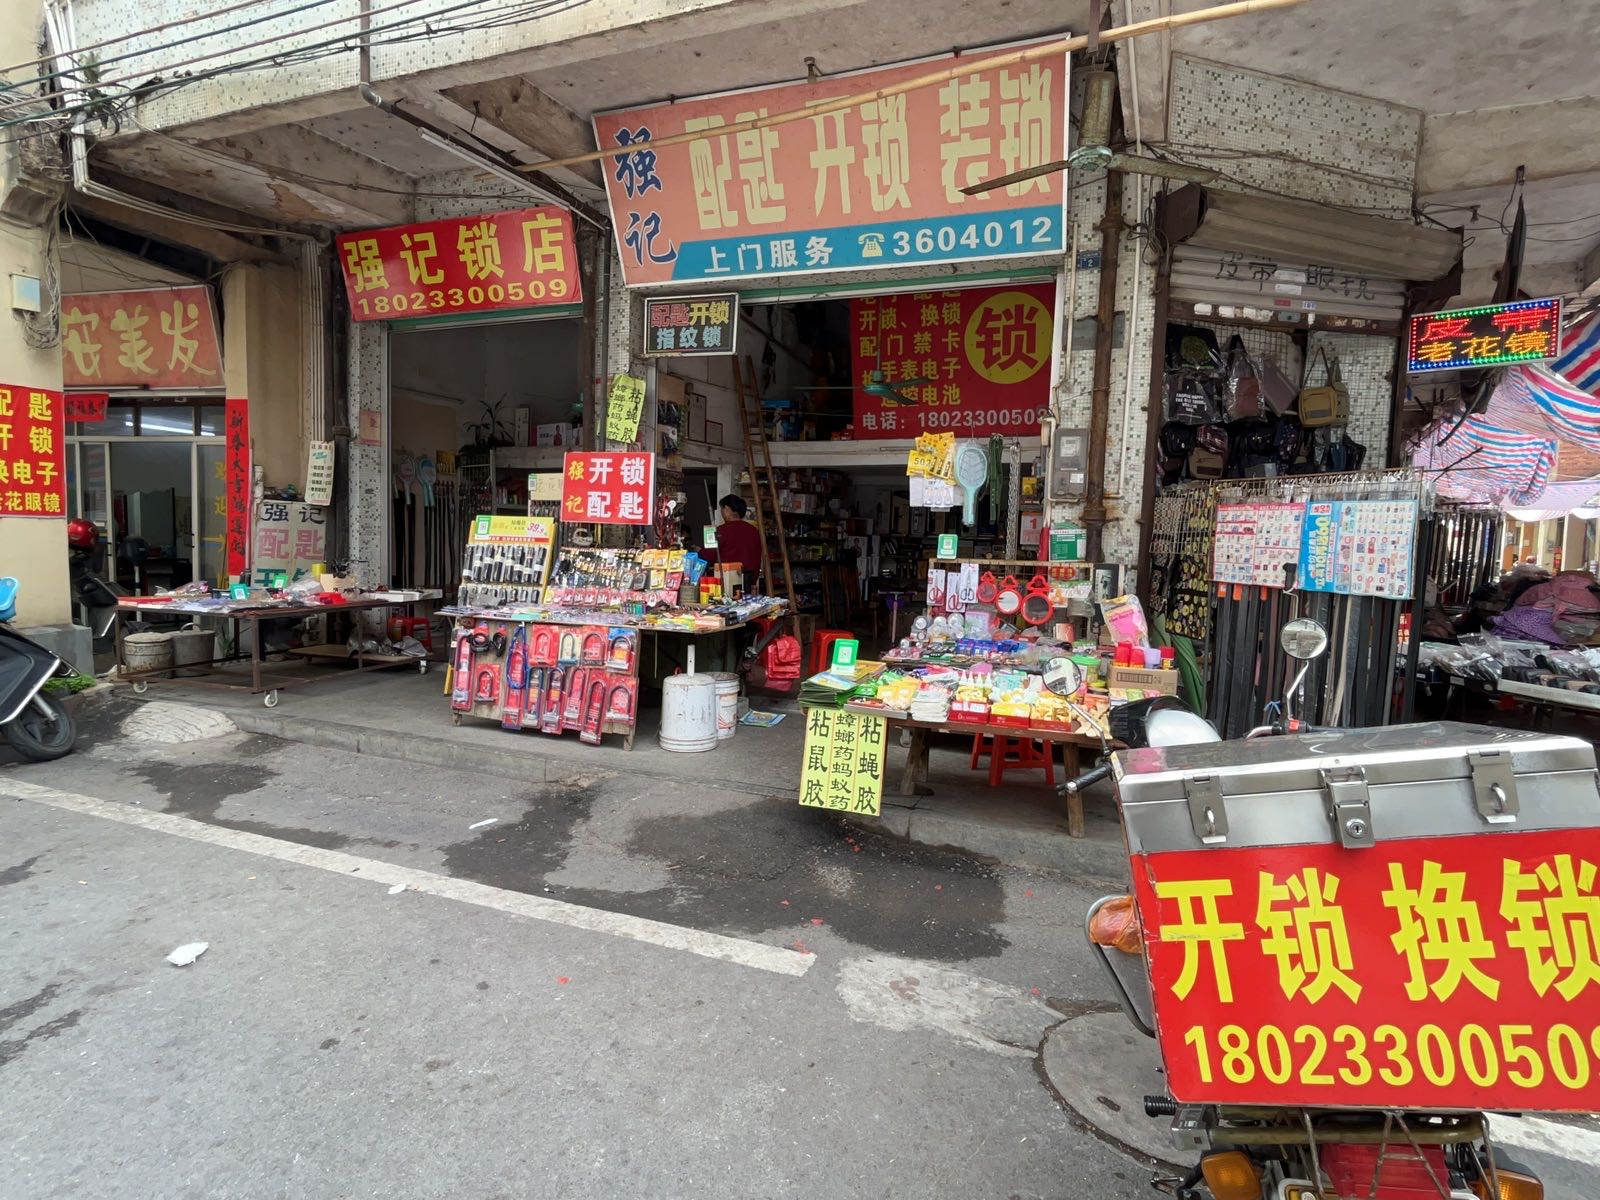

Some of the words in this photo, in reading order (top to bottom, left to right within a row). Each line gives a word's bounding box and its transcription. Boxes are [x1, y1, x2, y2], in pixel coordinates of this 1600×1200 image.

[685, 107, 787, 229] 配匙
[806, 93, 911, 217] 开锁
[939, 63, 1052, 203] 装锁
[614, 126, 679, 267] 强记
[344, 213, 565, 293] 强记锁店
[704, 236, 834, 273] 上门服务
[893, 216, 1052, 256] 3604012
[358, 279, 568, 315] 18023300509
[656, 326, 721, 350] 指纹锁
[859, 329, 961, 357] 配门禁卡
[976, 303, 1040, 371] 锁
[1418, 330, 1550, 362] 老花镜
[588, 457, 646, 486] 开锁
[0, 491, 61, 513] 花眼镜
[261, 503, 326, 525] 强记
[586, 490, 645, 520] 配匙
[258, 528, 324, 561] 配匙
[802, 710, 832, 807] 粘鼠胶
[828, 713, 857, 811] 蟑螂药蚂蚁药
[854, 716, 883, 815] 粘蝇胶
[1155, 867, 1362, 1004] 开锁
[1382, 854, 1600, 1003] 换锁
[1185, 1023, 1600, 1090] 1802330050
